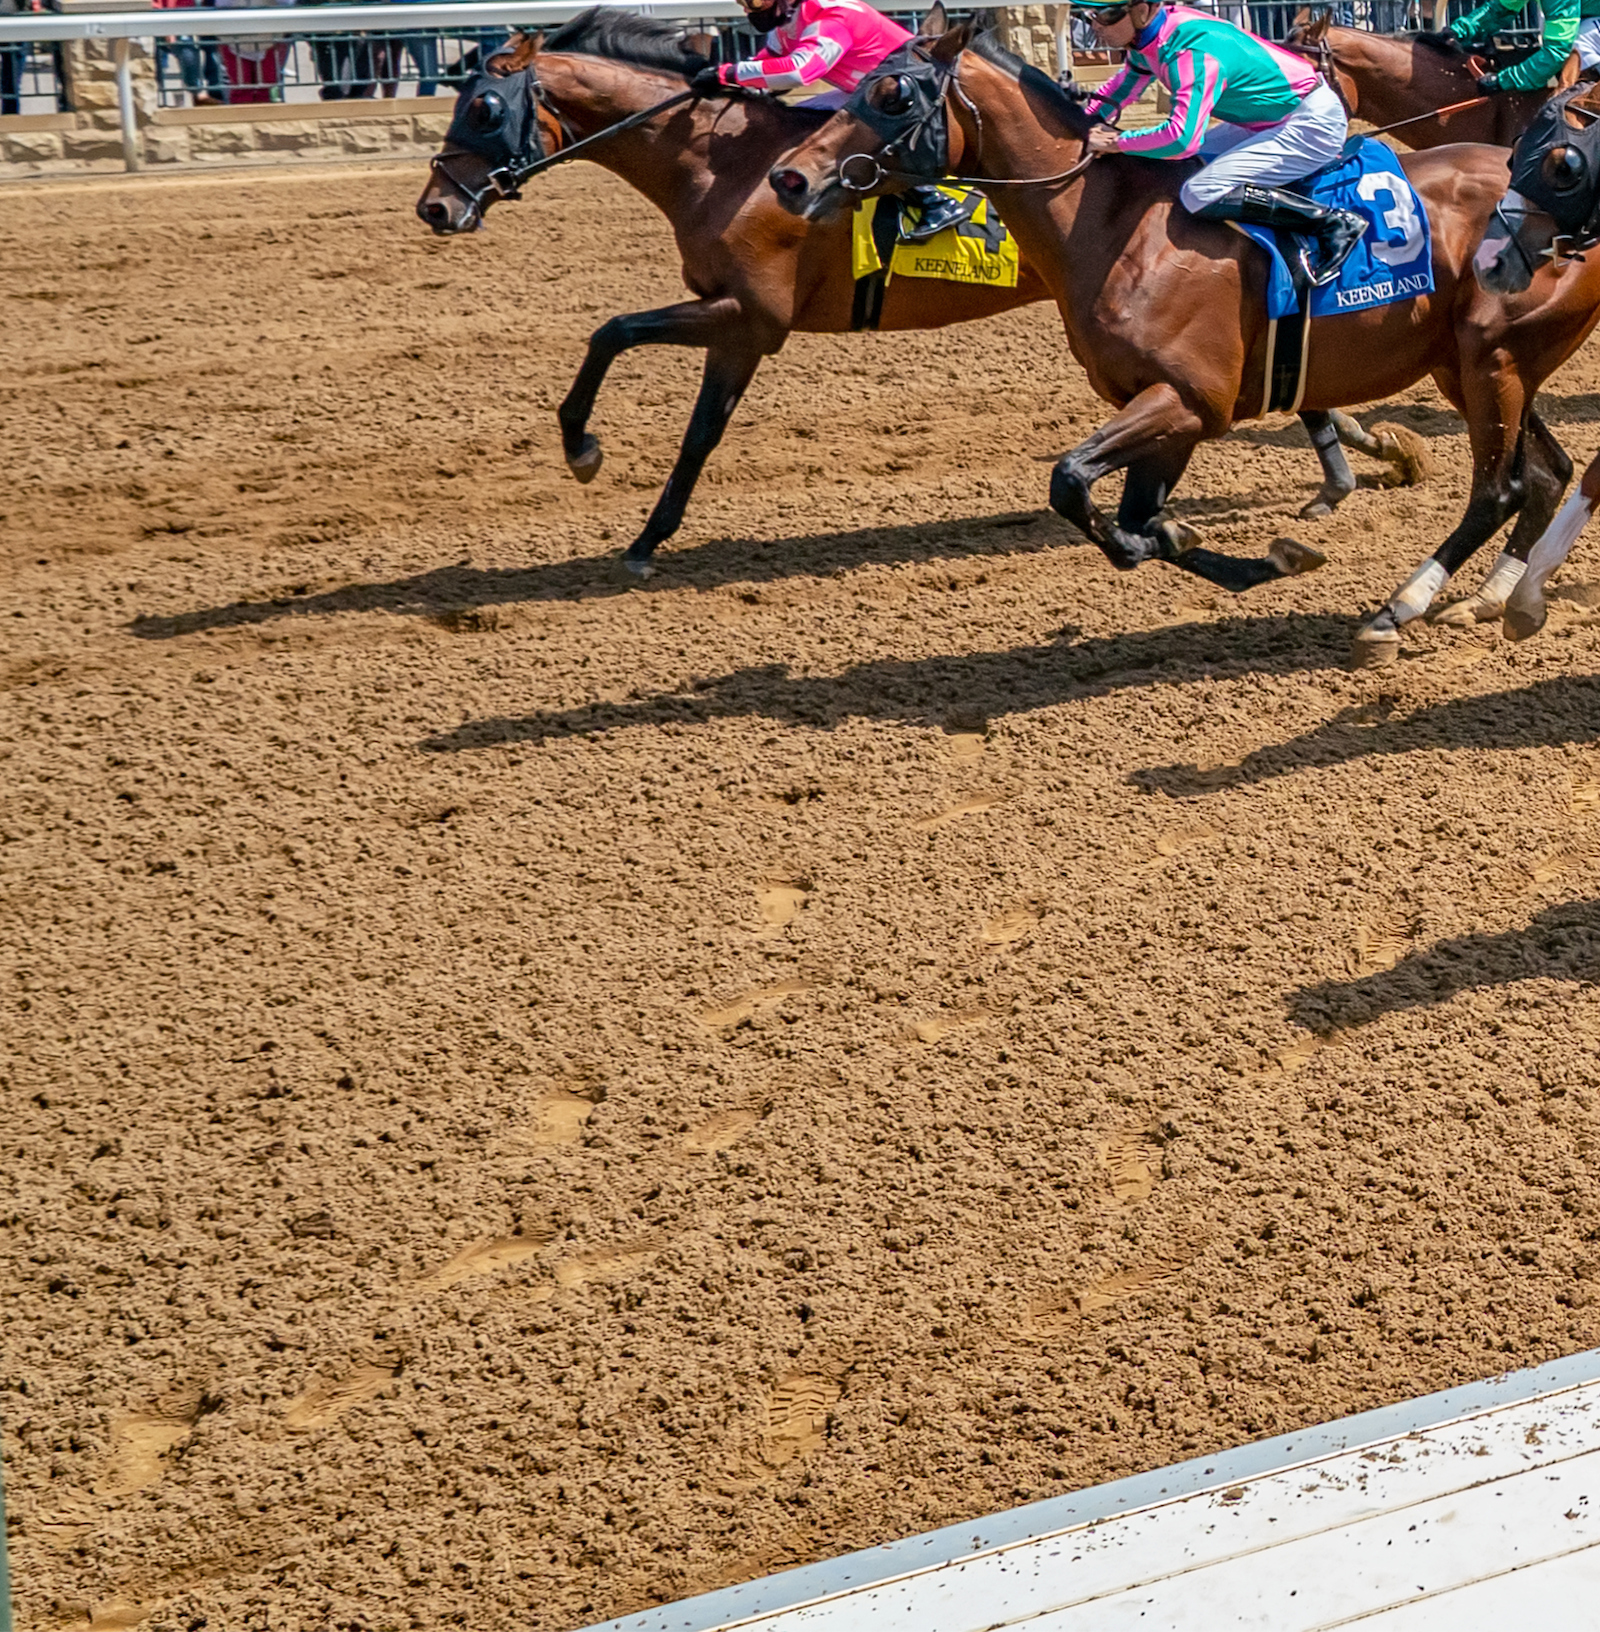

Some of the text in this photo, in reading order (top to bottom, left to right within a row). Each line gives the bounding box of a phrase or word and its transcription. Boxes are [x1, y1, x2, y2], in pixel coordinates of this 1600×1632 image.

[1356, 170, 1426, 266] 3
[913, 256, 1002, 281] KEENELAND
[1335, 272, 1430, 309] KEENELAND
